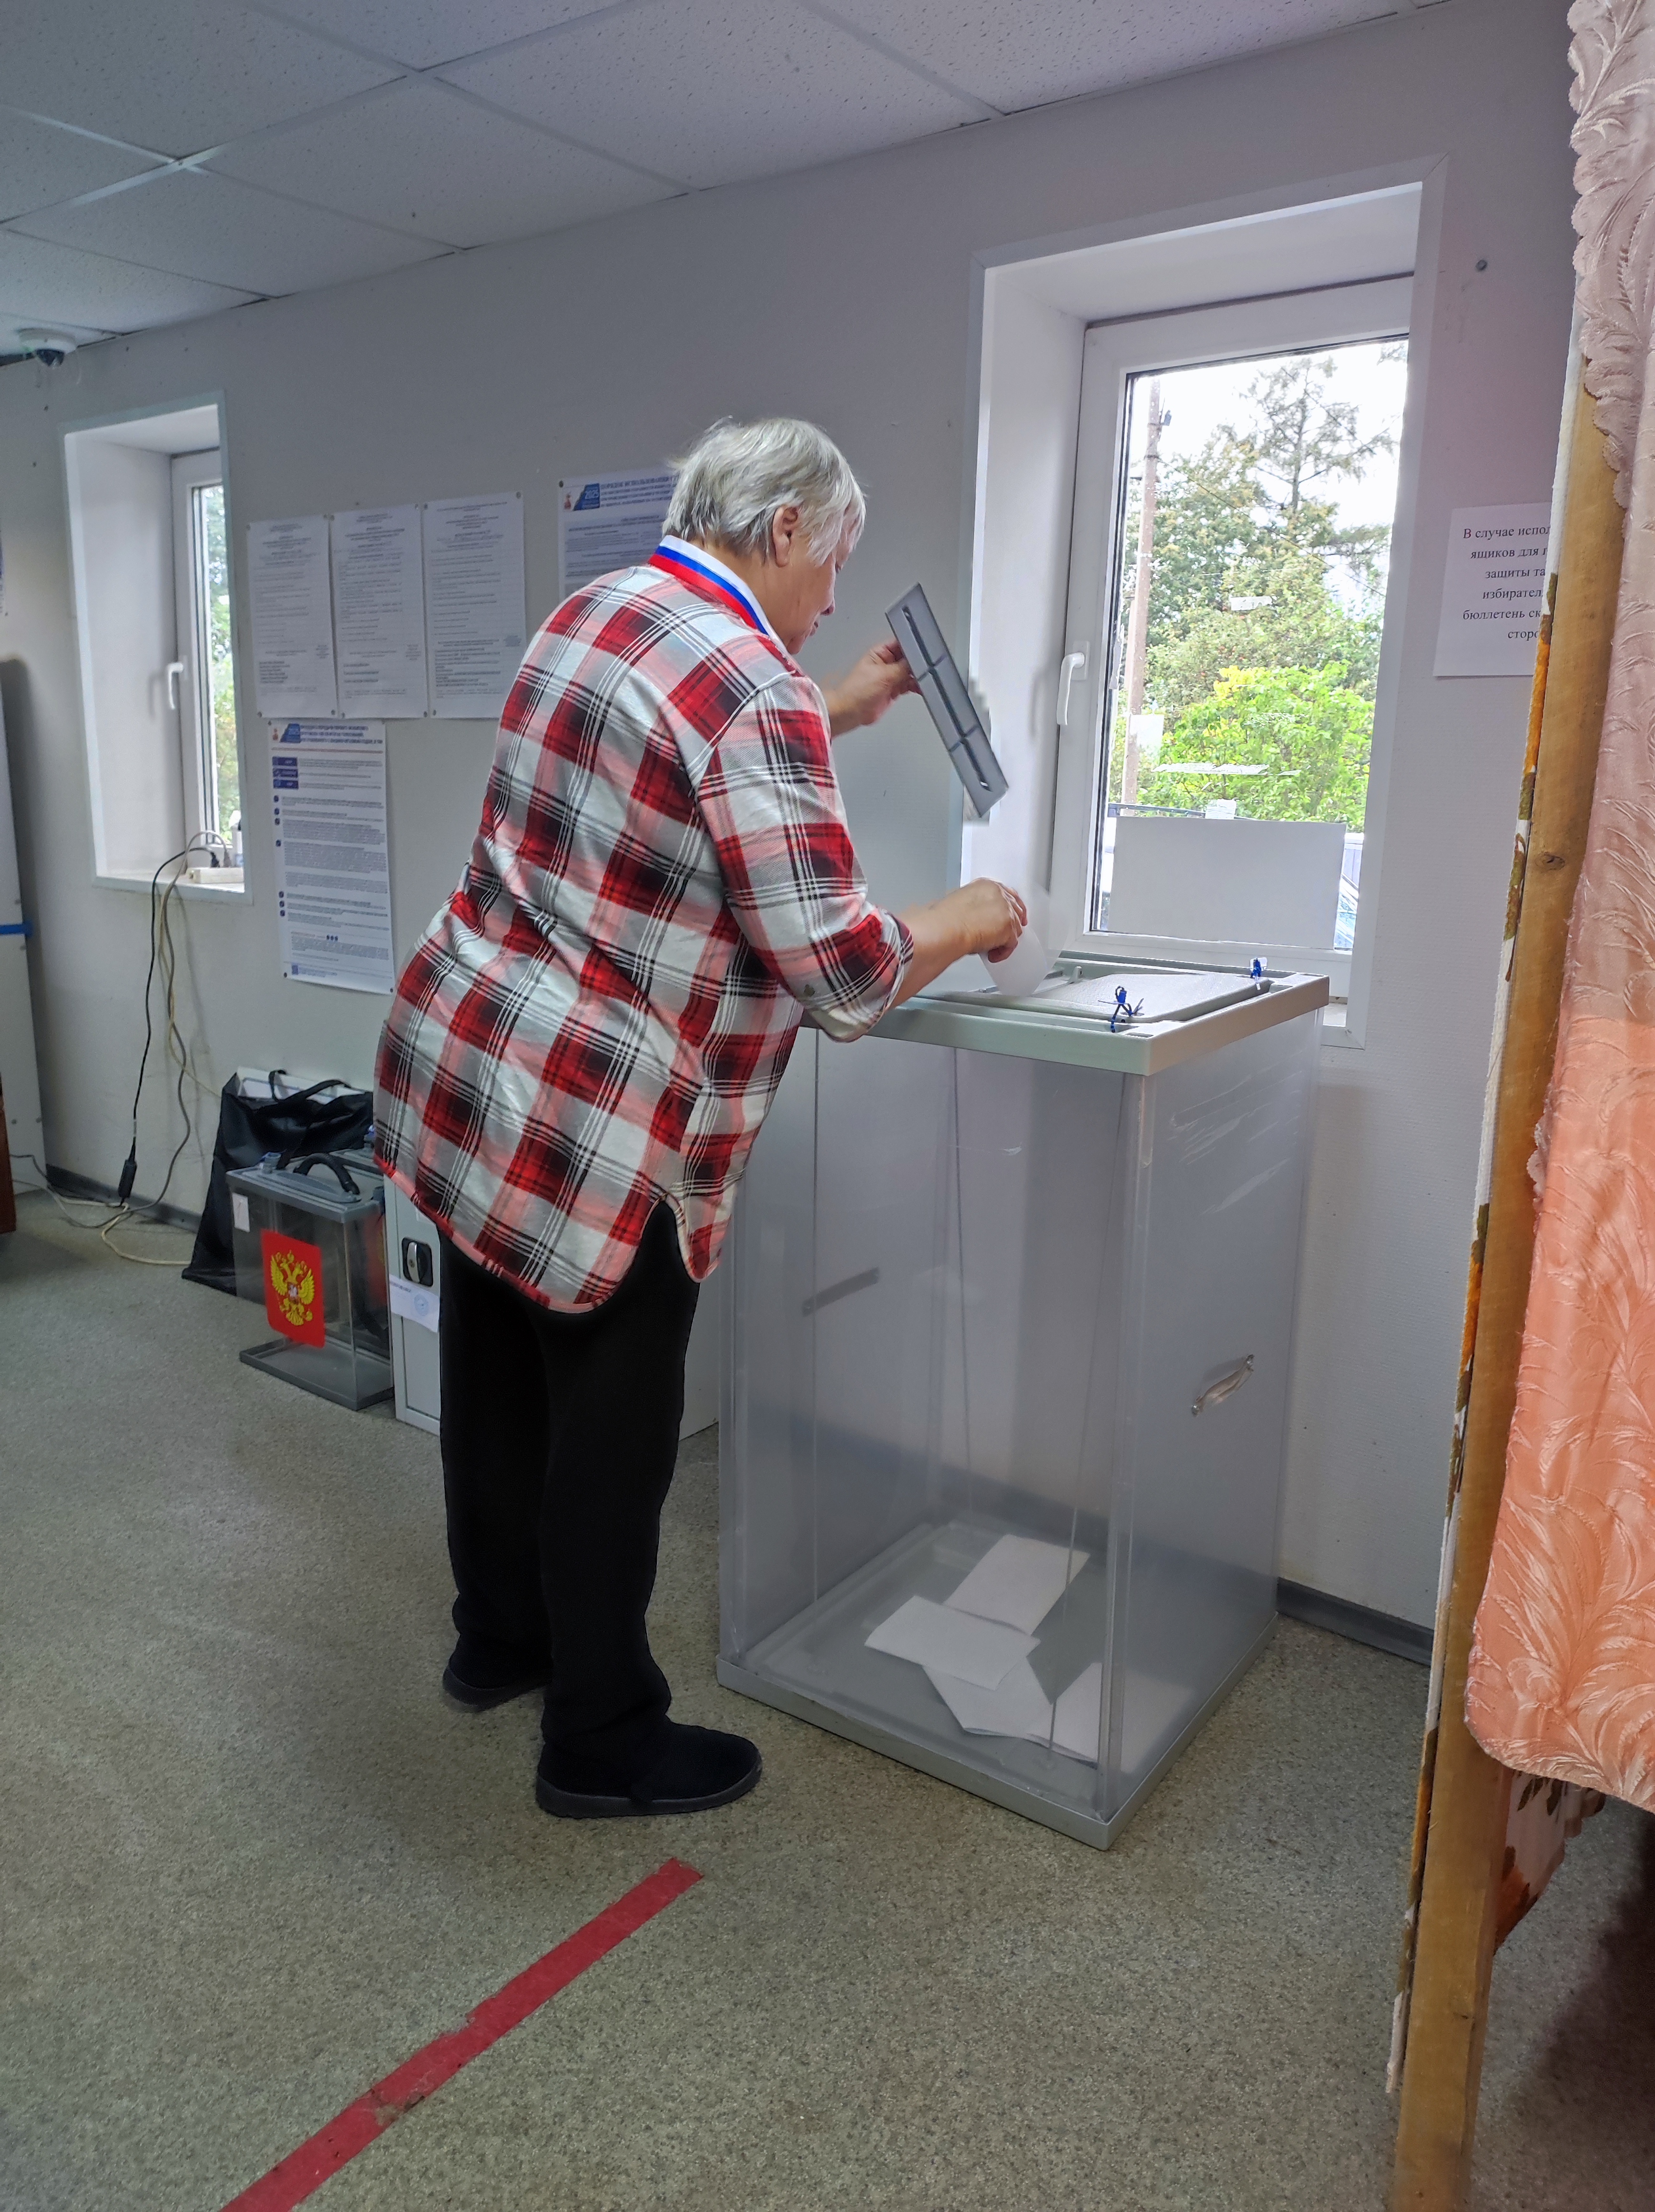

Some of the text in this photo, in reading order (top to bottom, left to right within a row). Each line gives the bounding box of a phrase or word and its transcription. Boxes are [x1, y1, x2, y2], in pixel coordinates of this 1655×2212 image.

[1463, 528, 1471, 539] В
[1475, 529, 1514, 540] случае
[1470, 550, 1515, 559] ящиков
[1517, 548, 1539, 557] для
[1485, 569, 1530, 579] защиты
[1483, 588, 1543, 601] избирател
[1463, 610, 1525, 620] бюллетень
